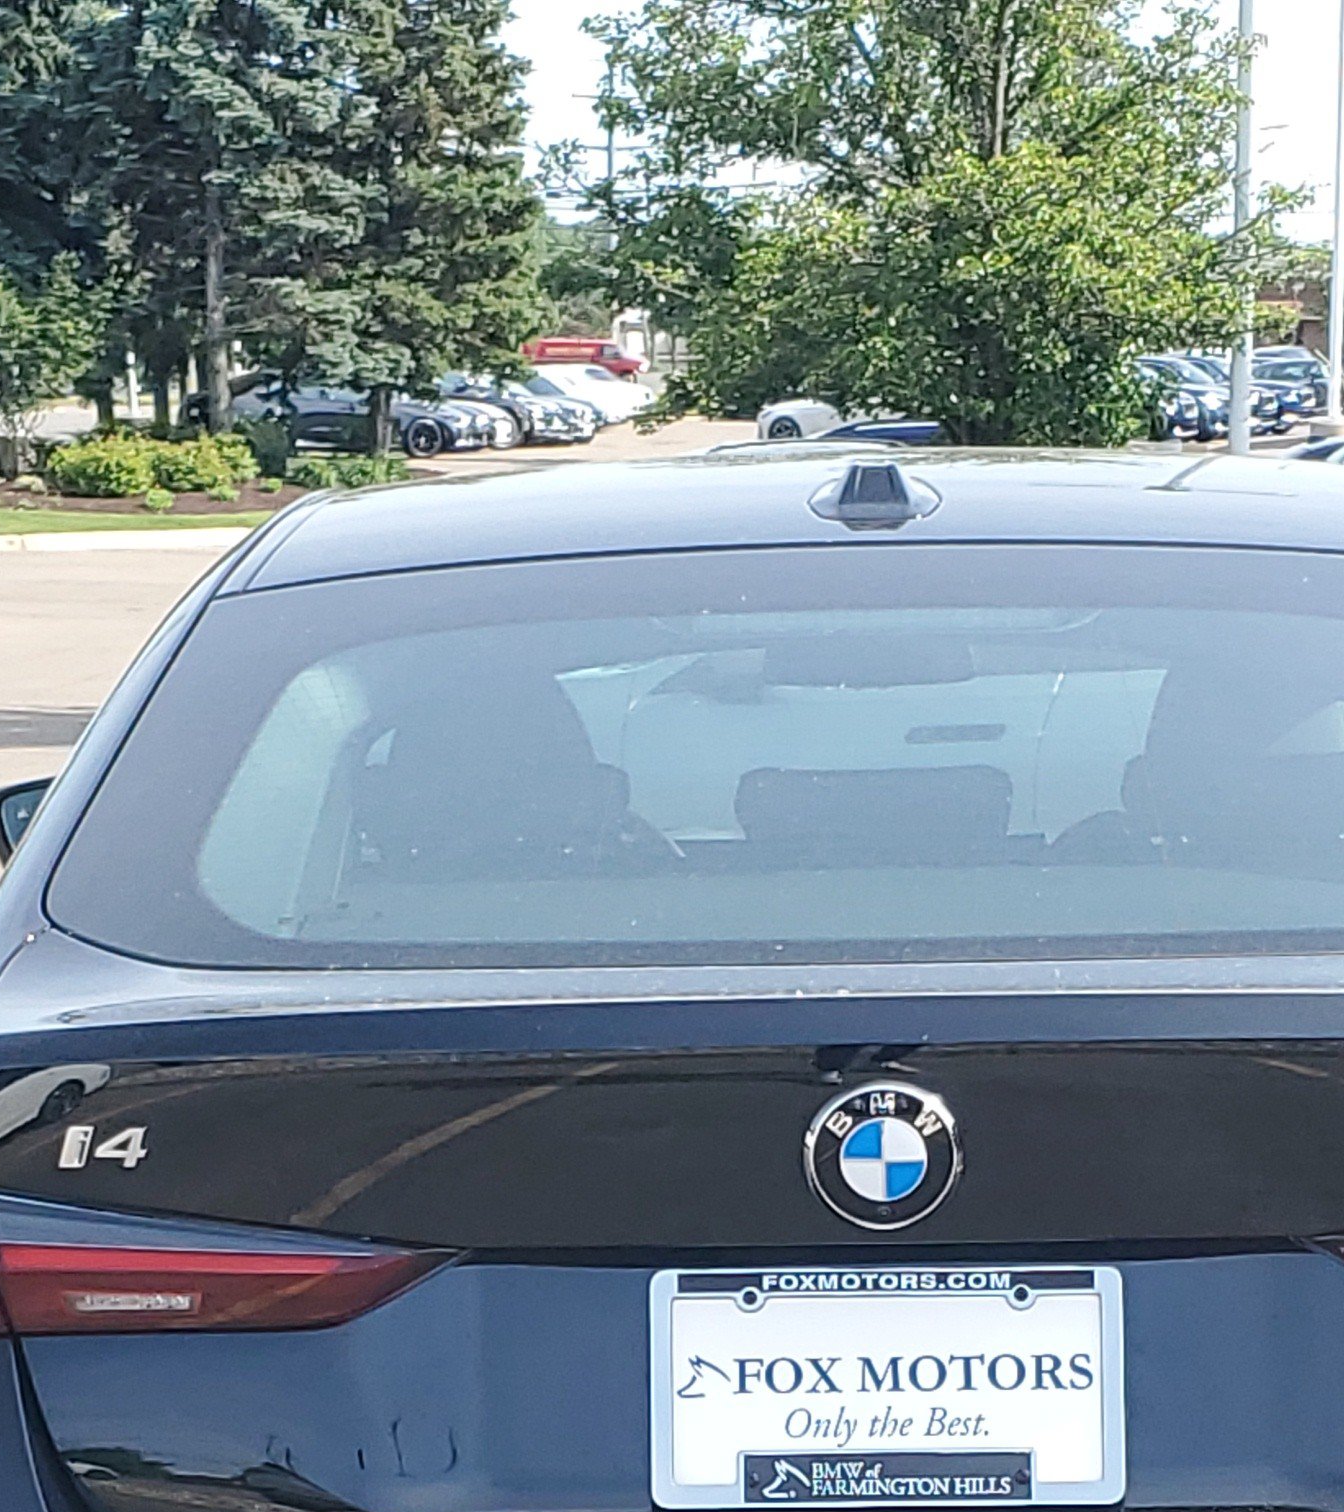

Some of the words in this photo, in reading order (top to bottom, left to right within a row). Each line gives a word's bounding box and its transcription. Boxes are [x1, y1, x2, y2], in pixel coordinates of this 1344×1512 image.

[825, 1092, 943, 1139] BMW
[58, 1125, 148, 1169] i4
[762, 1272, 1011, 1291] FOXMOTORS.COM
[732, 1357, 843, 1395] FOX
[856, 1353, 1094, 1393] MOTORS
[784, 1407, 858, 1447] Only
[868, 1407, 913, 1437] the
[924, 1406, 990, 1436] Best.
[811, 1463, 865, 1479] BMW
[865, 1463, 883, 1479] of
[811, 1477, 952, 1497] FARMINGTON
[954, 1476, 1012, 1495] HILLS
